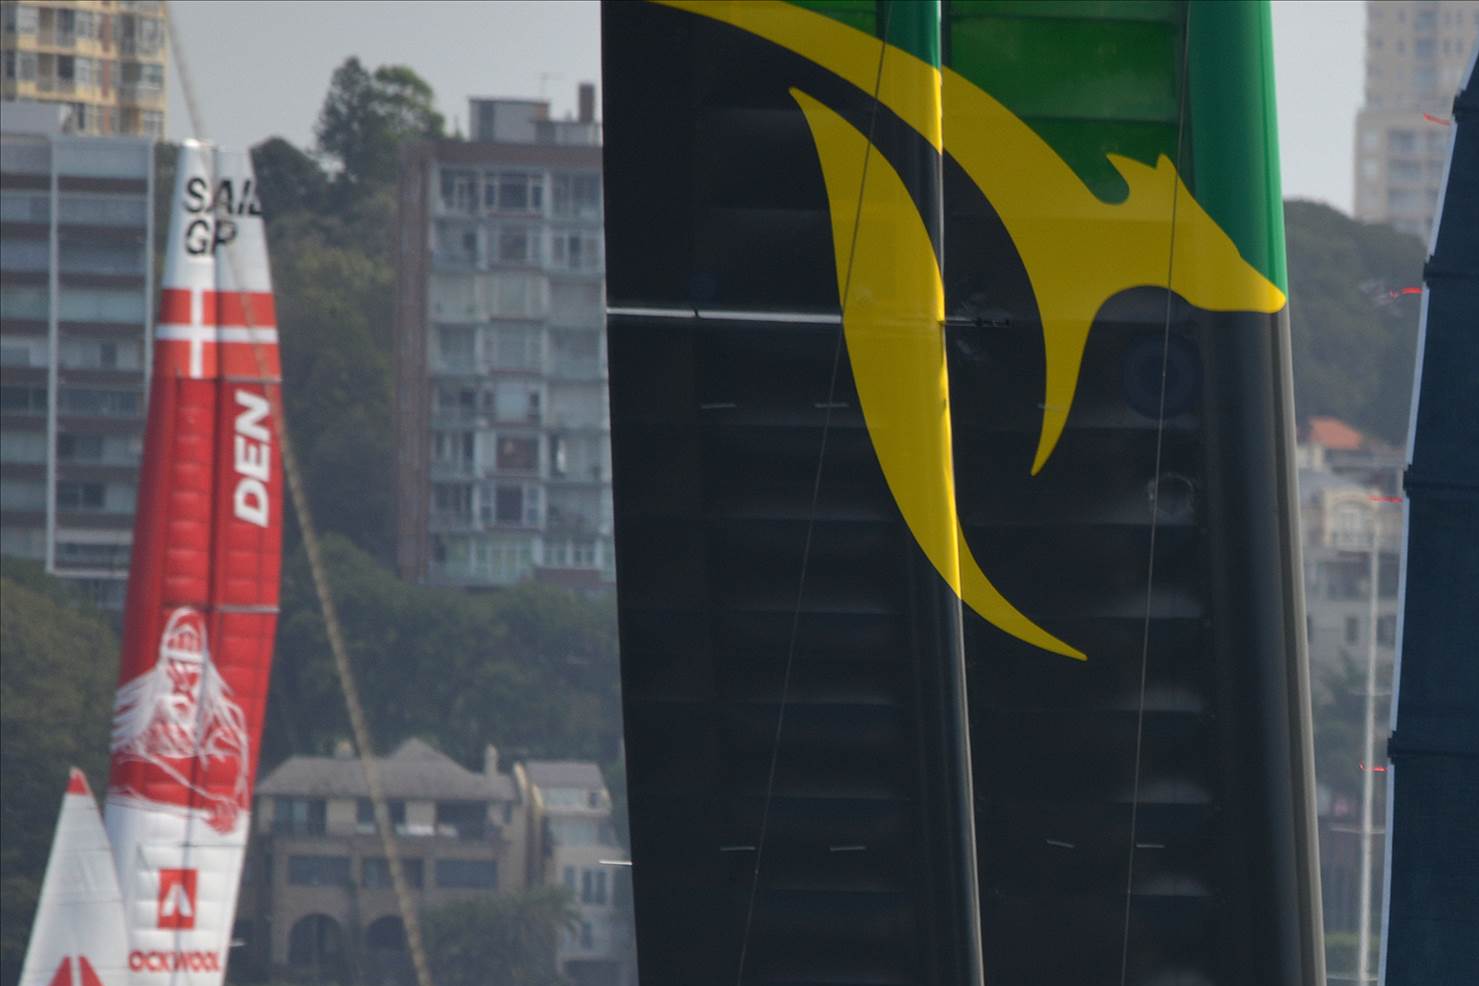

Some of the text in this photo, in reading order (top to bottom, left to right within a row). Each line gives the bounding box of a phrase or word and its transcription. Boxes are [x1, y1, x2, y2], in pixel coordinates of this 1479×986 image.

[184, 177, 264, 214] SAIL
[185, 219, 239, 256] GP
[234, 388, 271, 528] DEN
[128, 948, 220, 974] OCKWOOL
